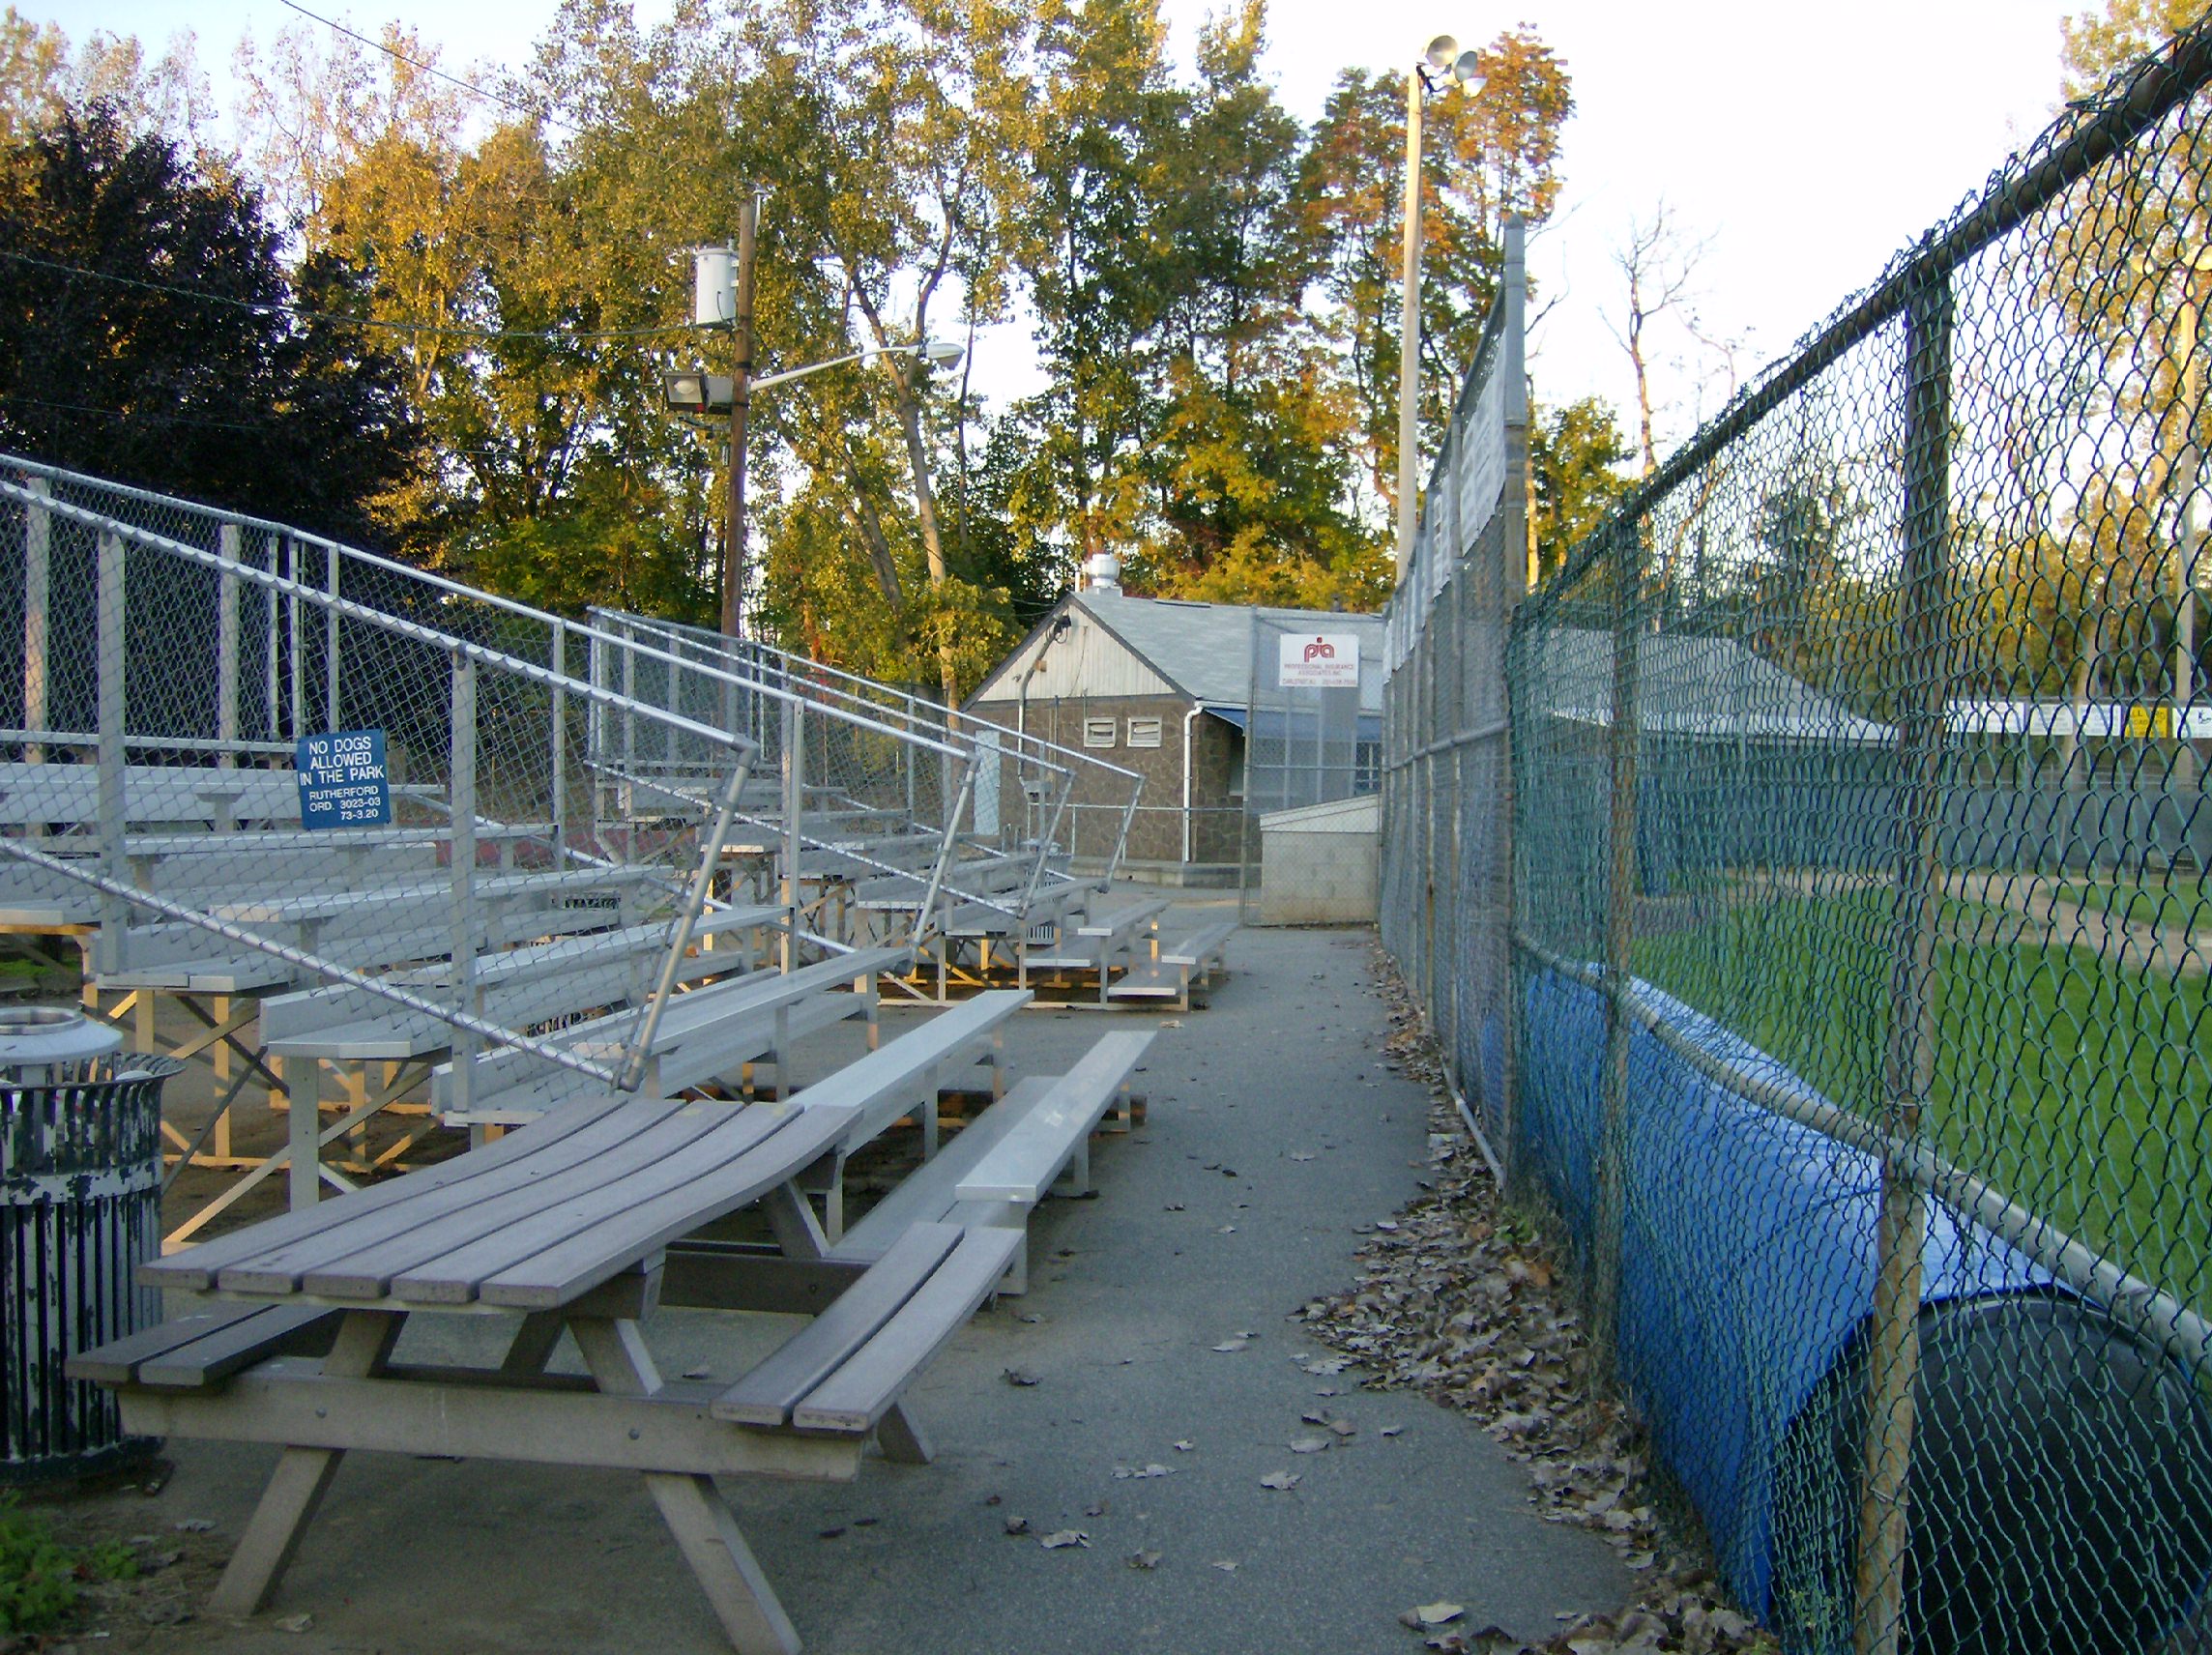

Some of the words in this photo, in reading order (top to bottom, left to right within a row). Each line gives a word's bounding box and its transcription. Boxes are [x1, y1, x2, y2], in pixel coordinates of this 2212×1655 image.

[309, 740, 329, 755] NO
[334, 736, 371, 753] DOGS
[310, 751, 372, 770] ALLOWED
[299, 771, 312, 786] IN
[318, 769, 344, 784] THE
[349, 765, 385, 781] PARK
[309, 785, 379, 800] RUTHERFORD
[309, 801, 335, 812] ORD.
[339, 797, 381, 809] 3023-03
